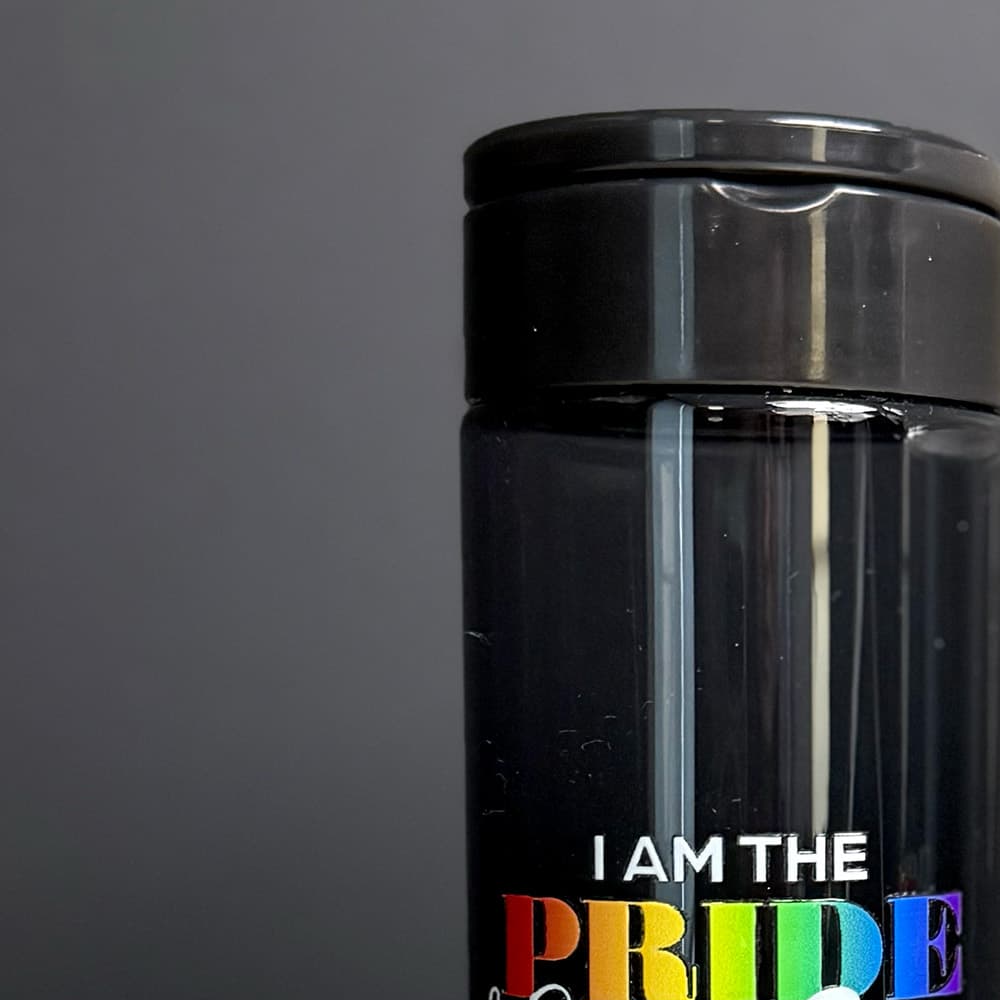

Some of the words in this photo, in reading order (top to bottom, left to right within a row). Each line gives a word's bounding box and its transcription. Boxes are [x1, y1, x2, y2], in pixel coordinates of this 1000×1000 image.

[593, 834, 605, 881] I
[622, 834, 724, 882] AM
[738, 832, 869, 882] THE
